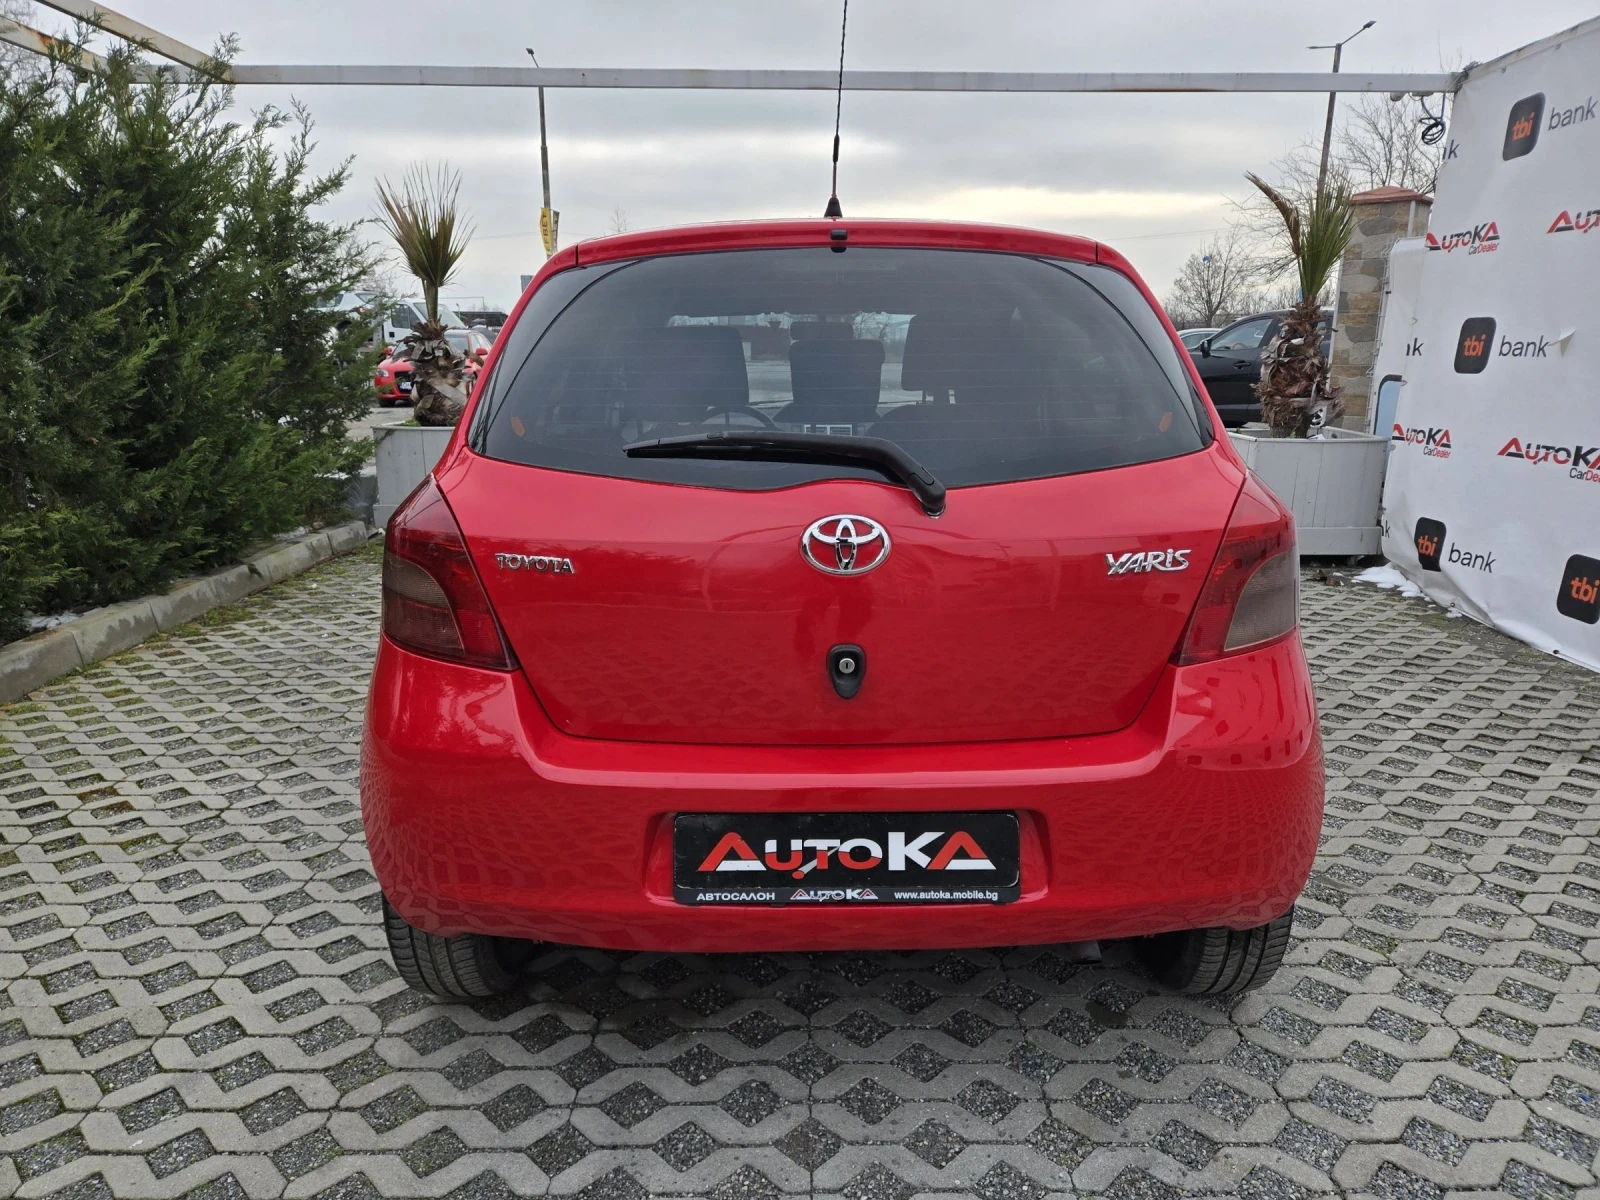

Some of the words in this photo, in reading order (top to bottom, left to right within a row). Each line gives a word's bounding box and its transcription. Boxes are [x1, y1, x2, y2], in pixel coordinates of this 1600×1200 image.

[1512, 112, 1535, 140] tbi
[1548, 96, 1599, 131] bank
[1425, 221, 1500, 253] AUTOKA
[1463, 334, 1487, 356] tbi
[1498, 335, 1549, 357] bank
[1391, 423, 1452, 448] AUTOKA
[495, 552, 575, 574] TOYOTA
[1417, 535, 1438, 557] tbi
[1448, 543, 1496, 573] bank
[1571, 576, 1600, 604] tbi
[696, 830, 997, 879] AUTOKA
[696, 892, 776, 901] АВТОСАЛОН
[789, 888, 879, 902] AUTOKA
[894, 890, 999, 901] www.autoka.mobile.bg
